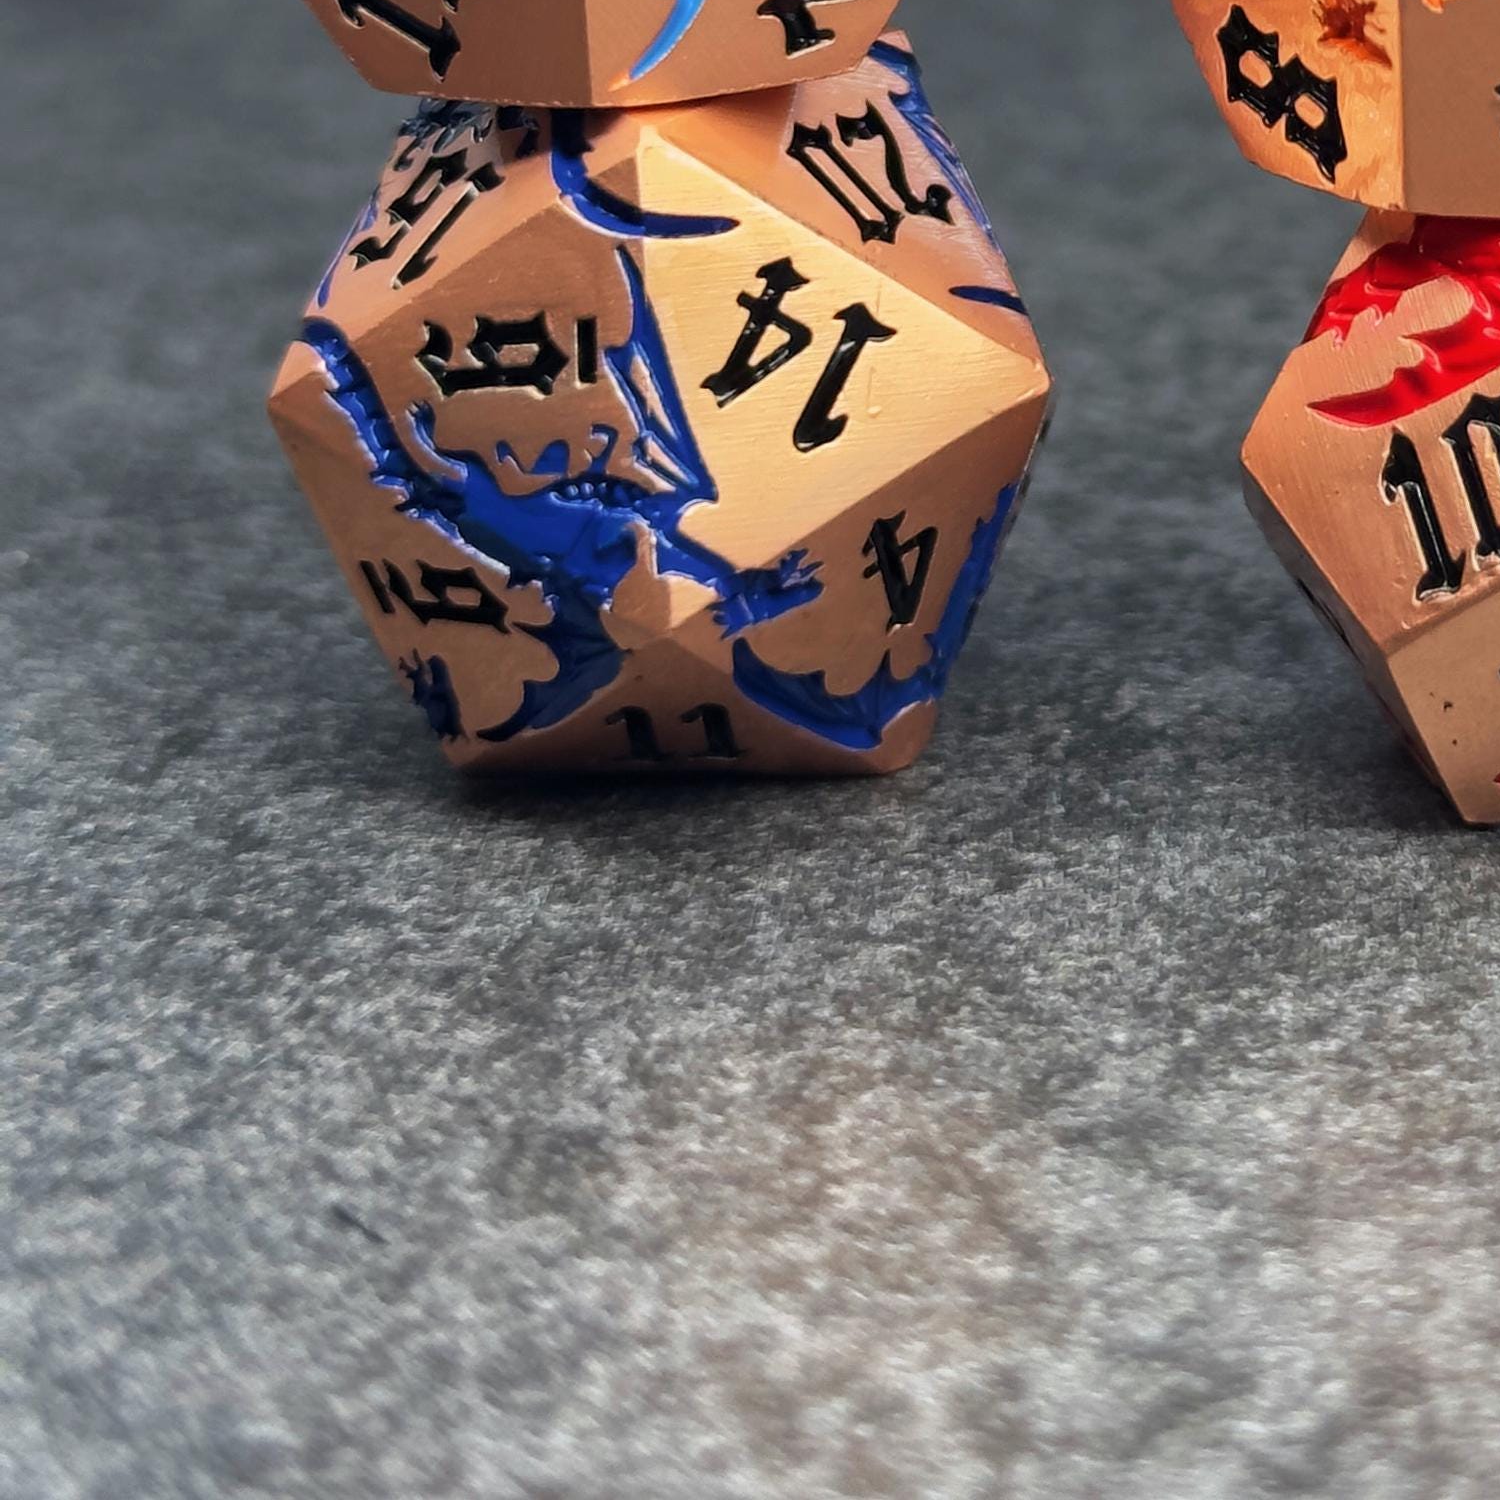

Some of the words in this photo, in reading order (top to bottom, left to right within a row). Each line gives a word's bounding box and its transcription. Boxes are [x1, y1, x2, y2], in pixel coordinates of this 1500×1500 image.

[1215, 3, 1348, 185] 8
[789, 100, 954, 245] 20
[700, 256, 898, 454] 14
[863, 510, 938, 633] 4
[604, 702, 746, 762] 11
